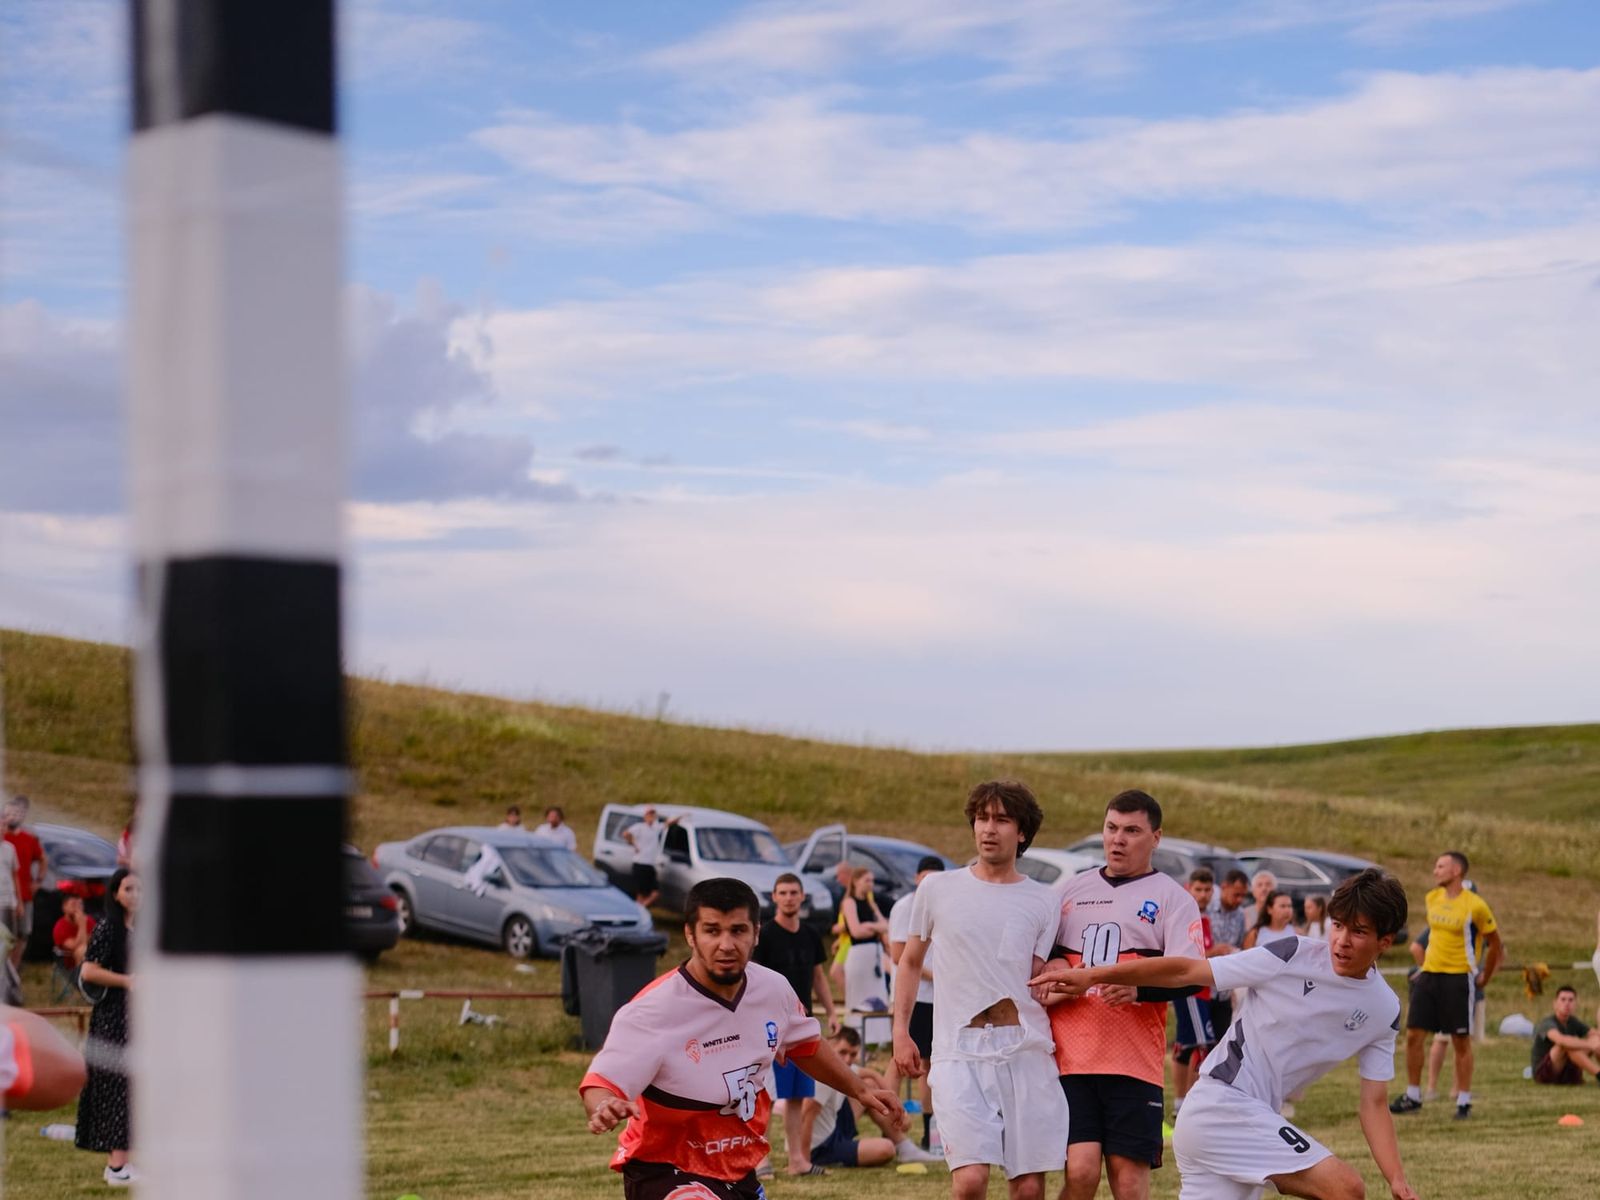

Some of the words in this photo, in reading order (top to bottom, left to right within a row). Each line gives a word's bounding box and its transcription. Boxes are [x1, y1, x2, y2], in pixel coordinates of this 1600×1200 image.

[1081, 921, 1122, 968] 10
[702, 1037, 723, 1049] WHITE
[723, 1033, 741, 1044] LIONS
[1278, 1125, 1311, 1154] 9
